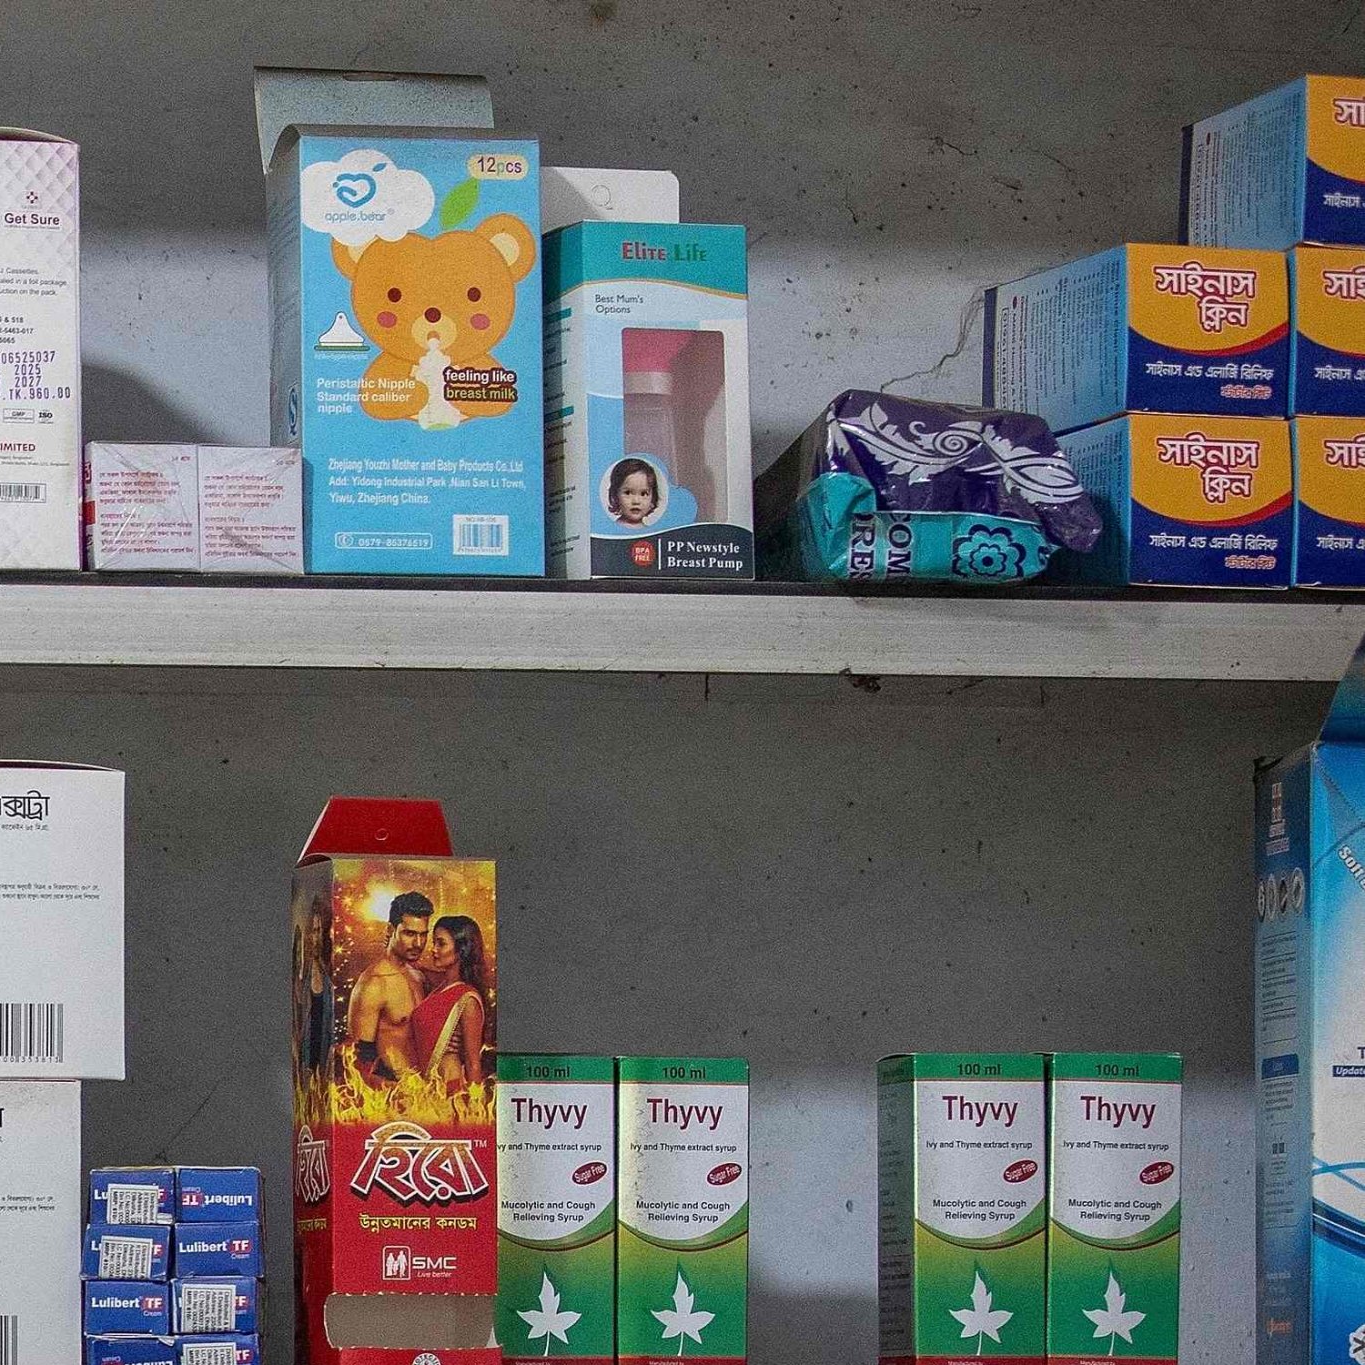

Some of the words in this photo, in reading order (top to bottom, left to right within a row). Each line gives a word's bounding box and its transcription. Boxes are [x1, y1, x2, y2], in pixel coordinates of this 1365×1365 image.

[4, 213, 28, 225] Get
[31, 213, 60, 225] Sure
[1155, 263, 1255, 297] সাইনাস
[14, 363, 41, 375] 2025
[14, 375, 41, 388] 2027
[444, 369, 489, 385] feeling
[492, 369, 515, 382] like
[446, 387, 486, 399] breast
[489, 387, 515, 400] milk
[1159, 434, 1258, 467] সাইনাস
[667, 541, 684, 552] PP
[687, 541, 740, 555] Newstyle
[667, 556, 707, 567] Breast
[709, 557, 743, 570] Pump
[511, 1098, 587, 1130] Thyvy
[647, 1098, 723, 1131] Thyvy
[941, 1095, 1019, 1128] Thyvy
[1080, 1096, 1156, 1129] Thyvy
[636, 1200, 674, 1211] Mucolytic
[677, 1201, 692, 1211] and
[694, 1201, 731, 1212] Cough
[436, 1215, 477, 1231] কনডম
[648, 1213, 689, 1223] Relieving
[692, 1213, 719, 1224] Syrup
[178, 1241, 228, 1252] Lulibert
[232, 1240, 250, 1252] TF
[413, 1257, 457, 1269] SMC
[91, 1297, 140, 1308] Lulibert
[145, 1297, 162, 1308] TF
